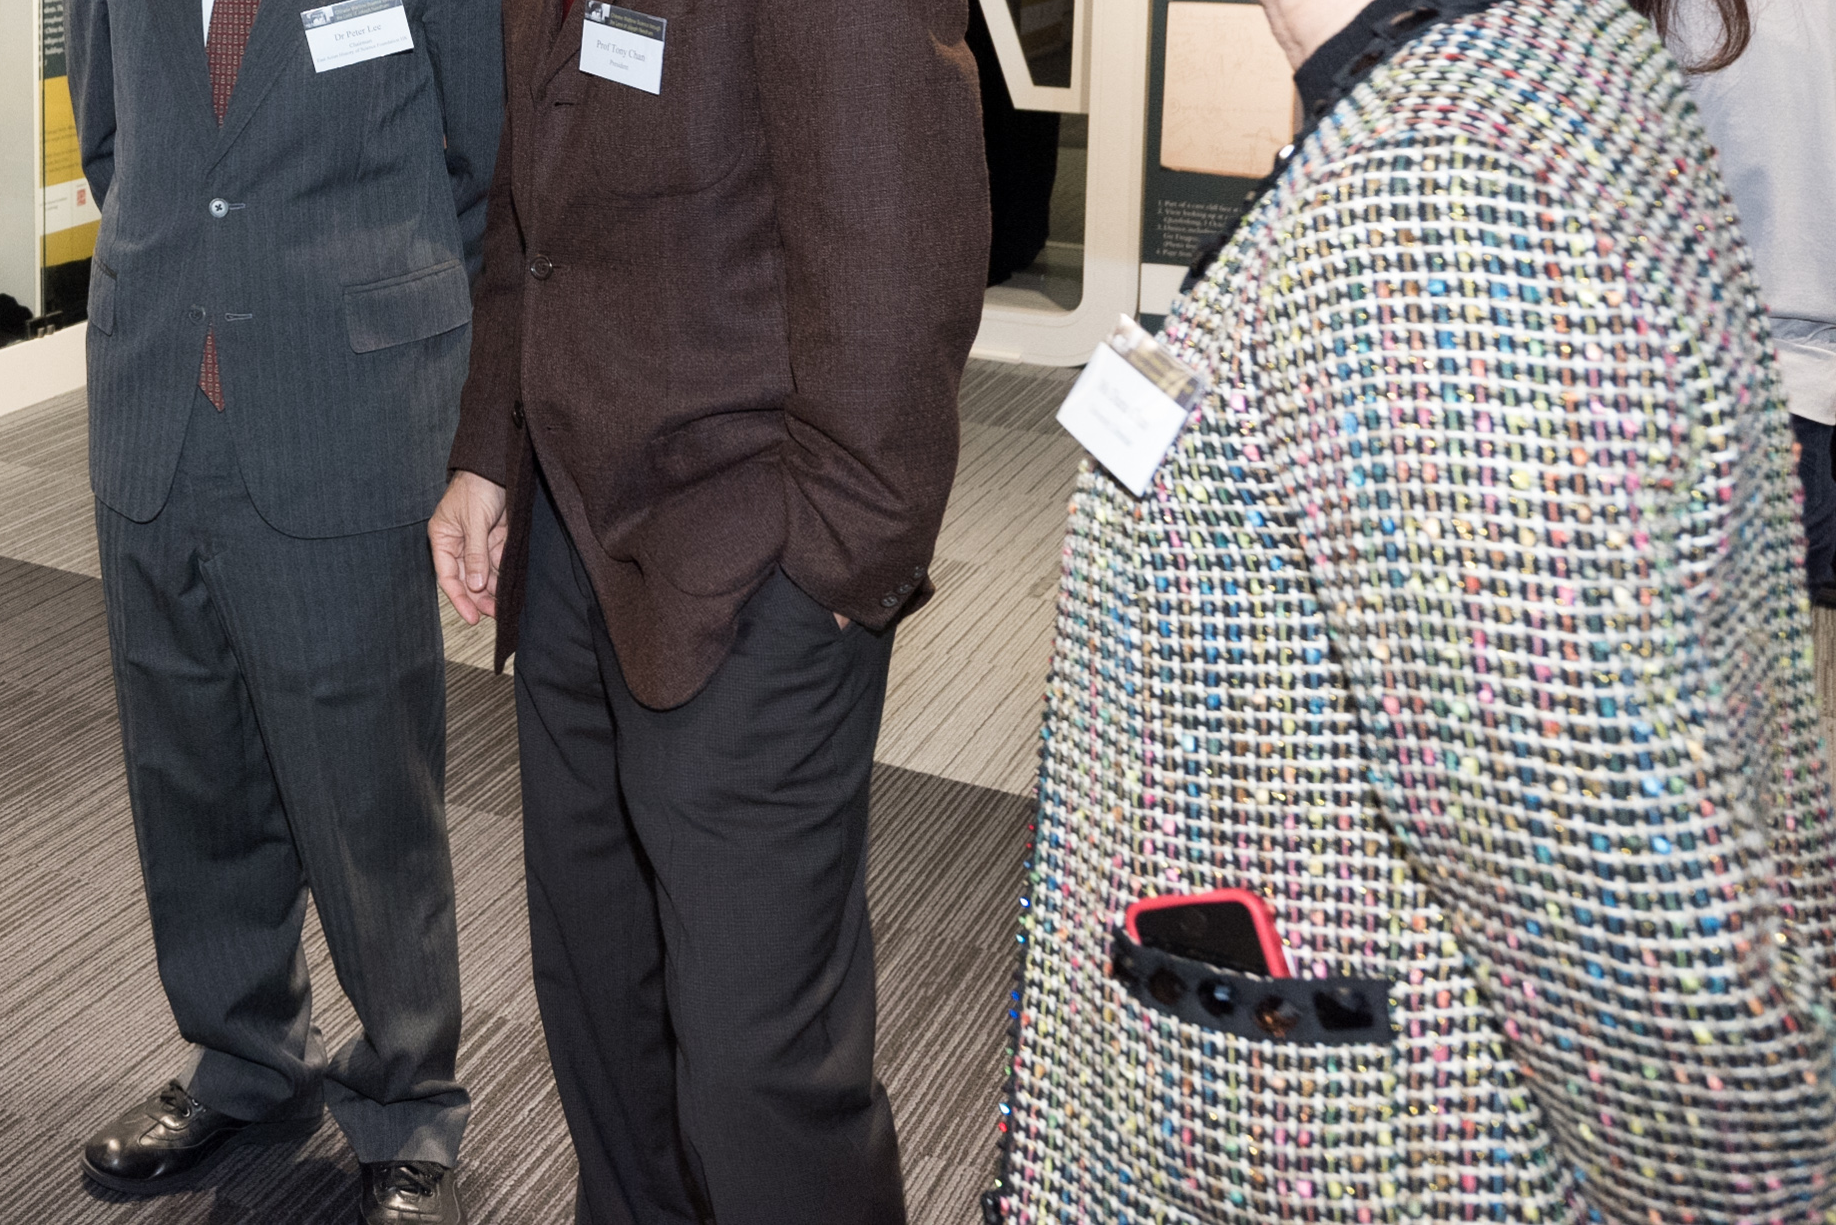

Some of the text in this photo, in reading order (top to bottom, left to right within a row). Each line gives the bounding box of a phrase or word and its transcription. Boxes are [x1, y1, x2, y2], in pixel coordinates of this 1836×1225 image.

[334, 24, 382, 42] Dr Peter Lee
[596, 39, 645, 62] Prof Tony Chan
